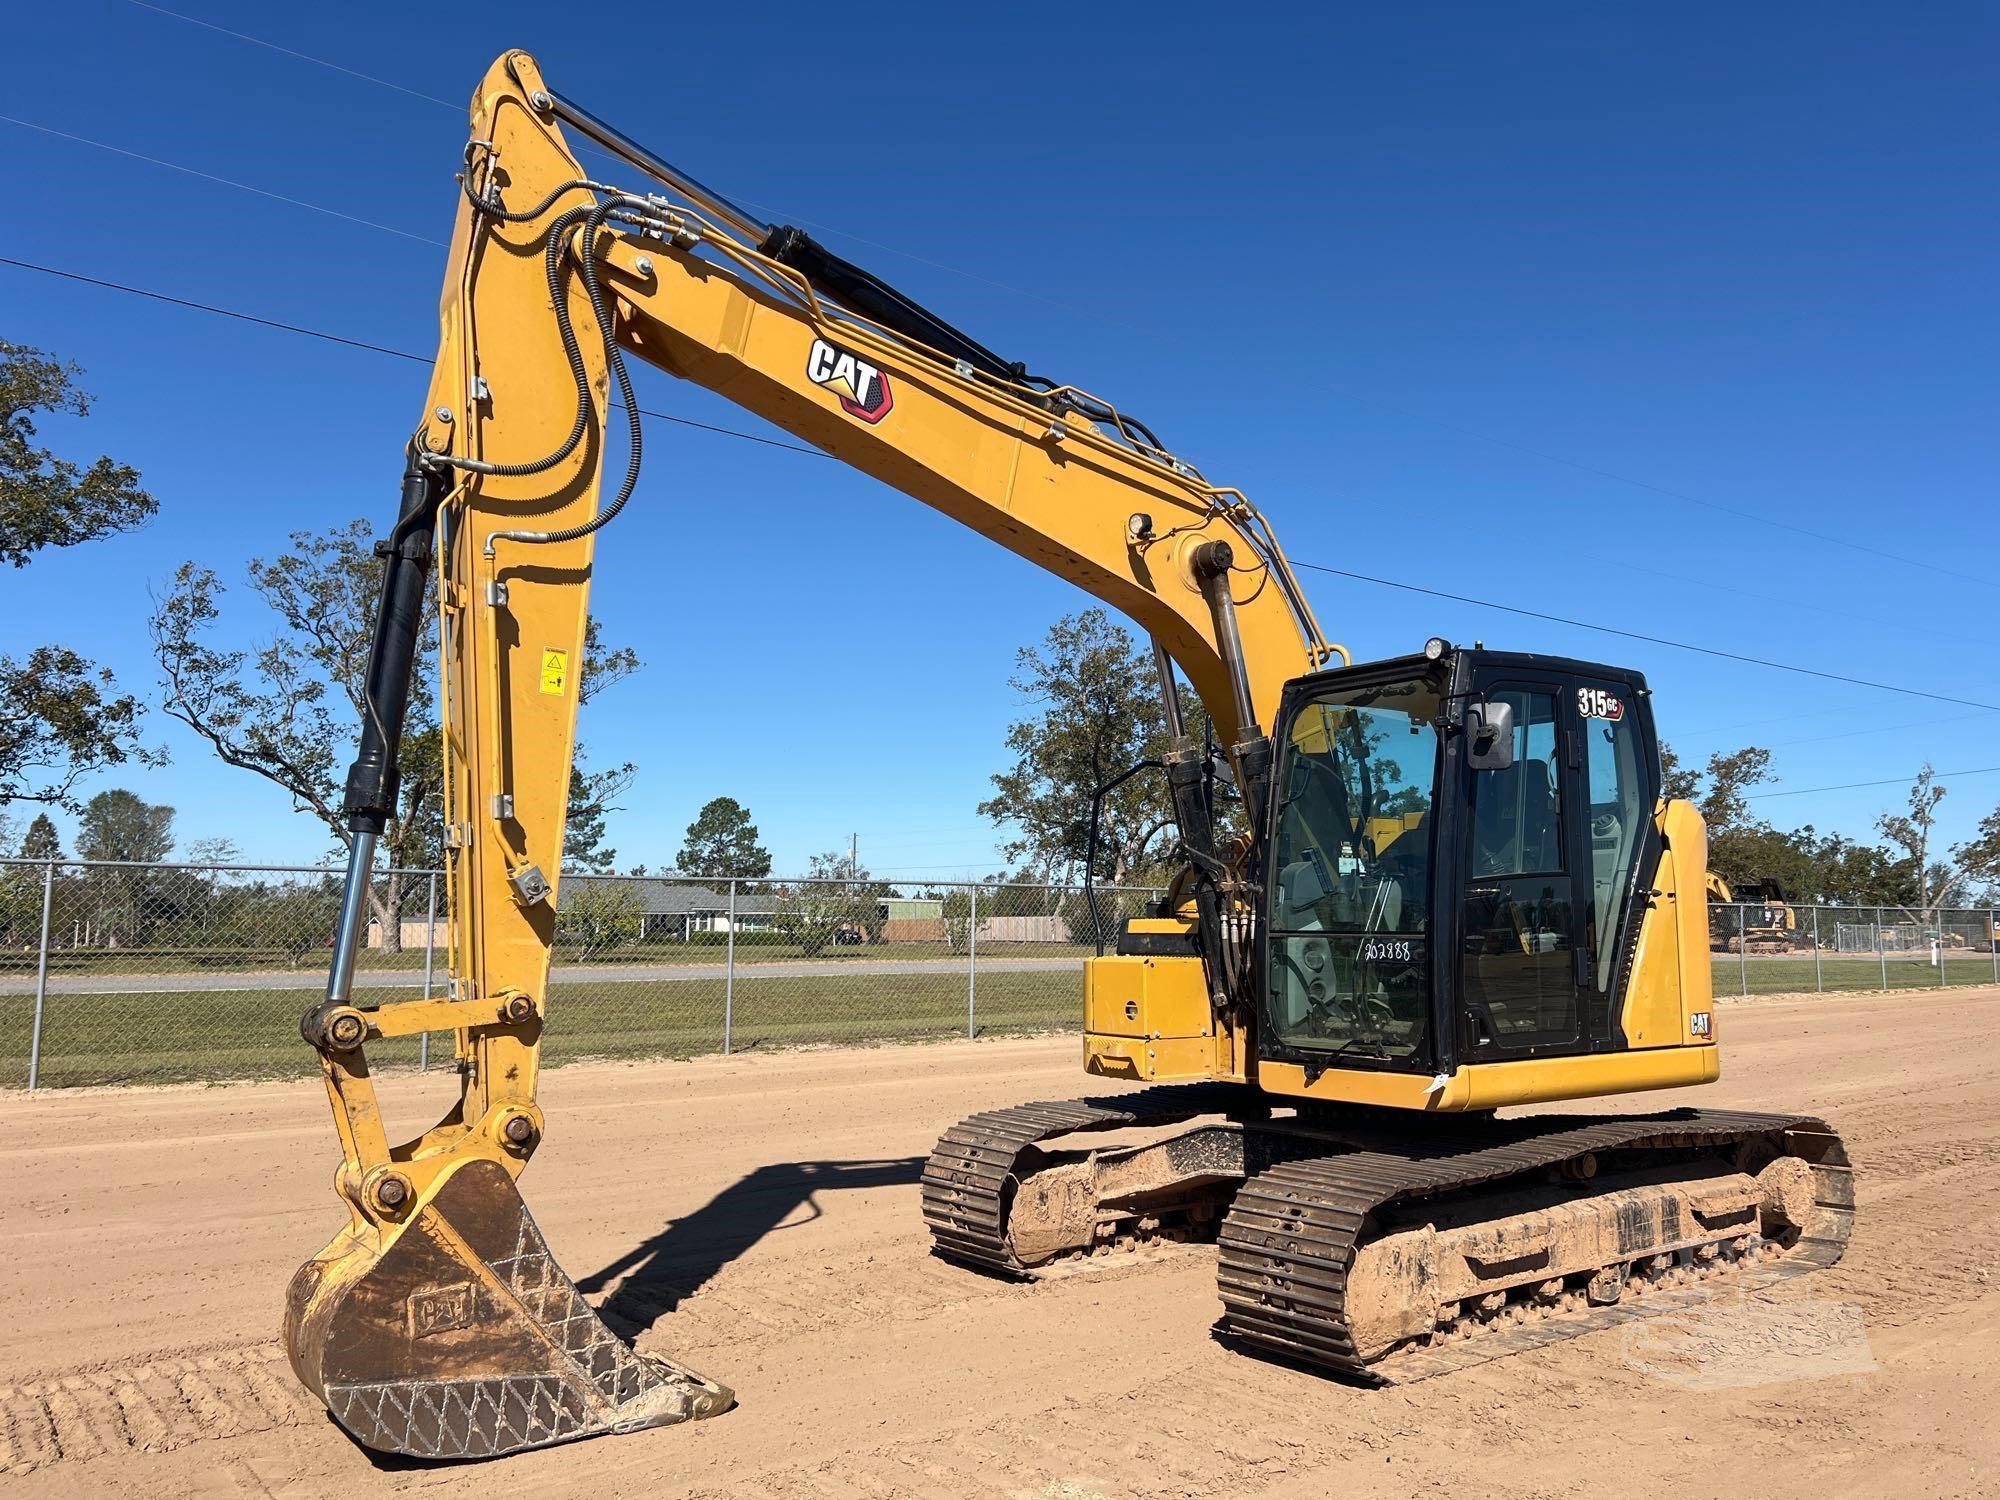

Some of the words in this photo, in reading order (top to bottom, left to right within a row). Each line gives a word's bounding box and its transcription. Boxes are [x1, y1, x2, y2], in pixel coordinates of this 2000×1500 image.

[808, 339, 878, 407] CAT
[1365, 941, 1410, 961] 202888
[1690, 1013, 1709, 1035] CAT
